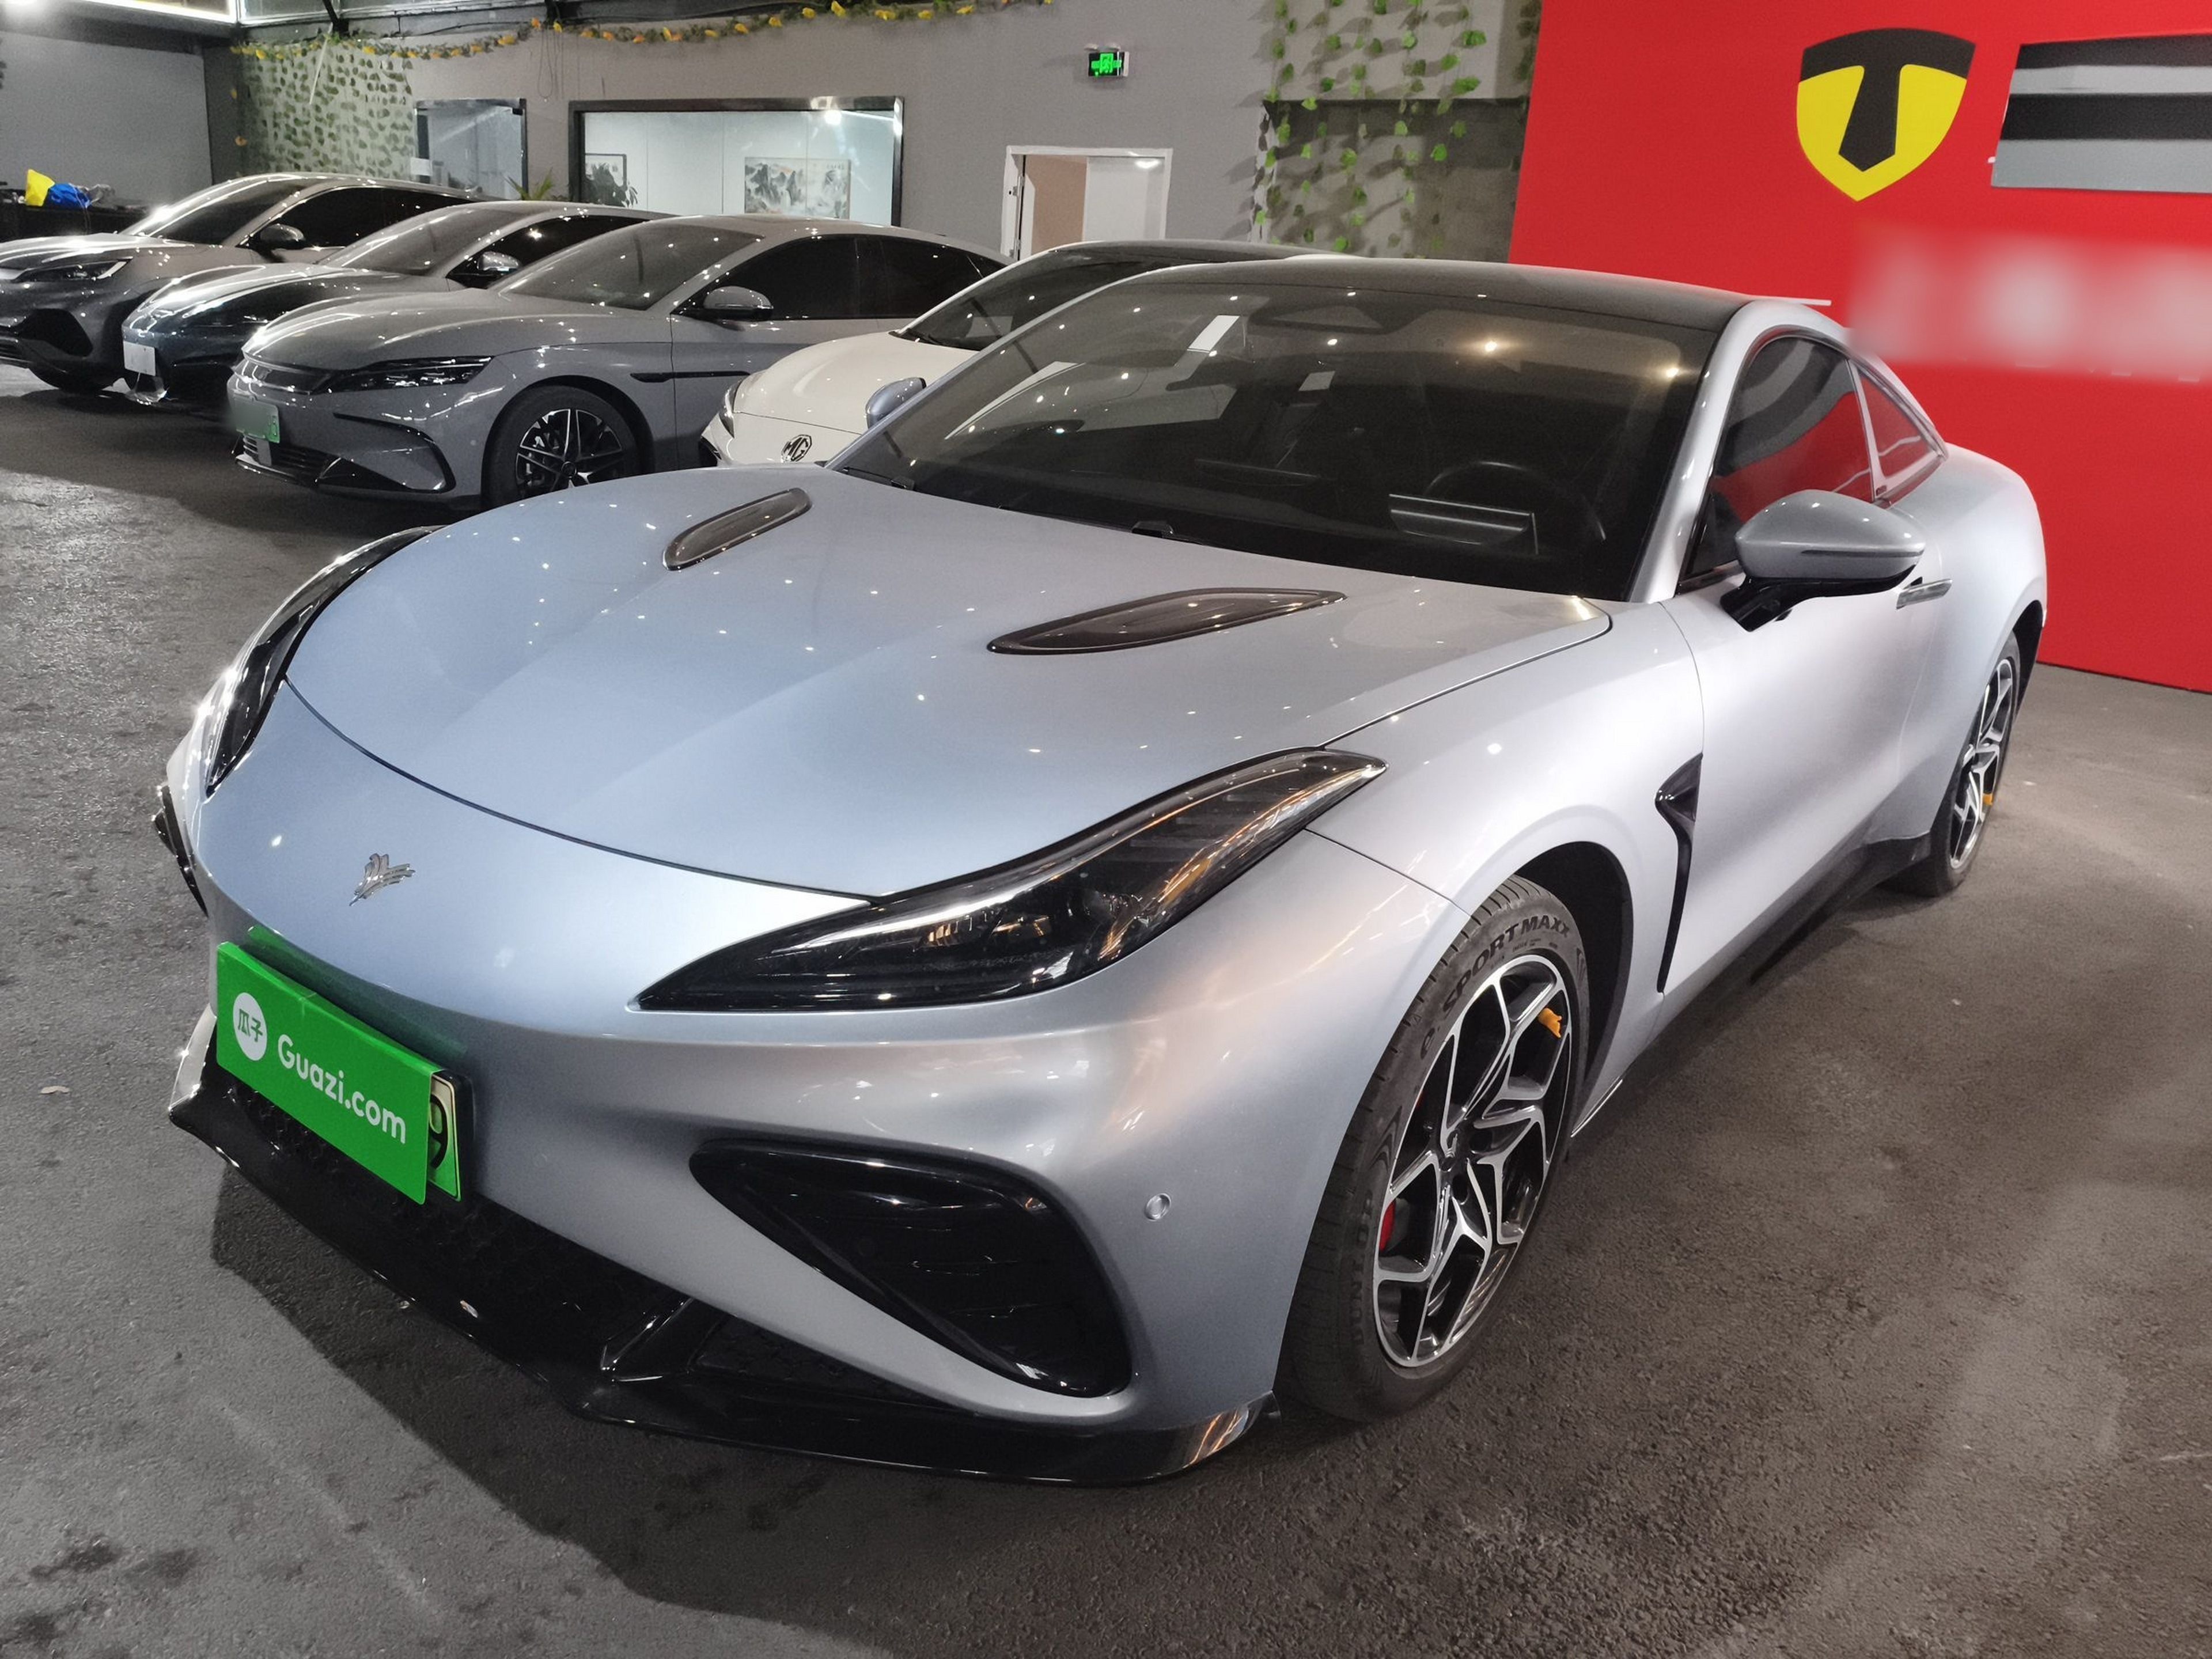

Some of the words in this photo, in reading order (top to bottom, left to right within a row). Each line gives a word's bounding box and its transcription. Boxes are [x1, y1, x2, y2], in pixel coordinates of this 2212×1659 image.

[782, 435, 810, 462] MG
[1442, 923, 1520, 1019] SPORT
[1521, 914, 1571, 937] MAXX
[237, 1008, 263, 1043] 瓜子
[277, 1033, 406, 1144] Guazi.com
